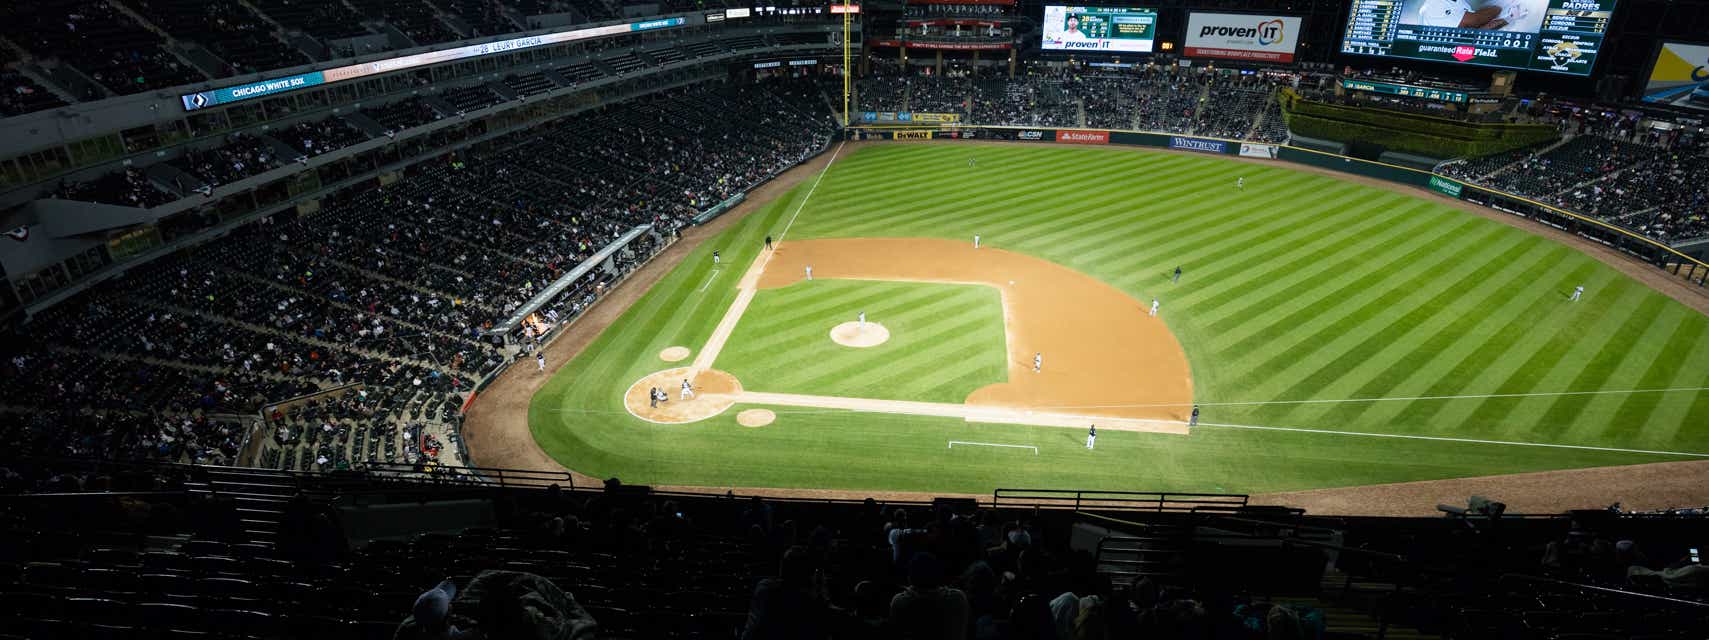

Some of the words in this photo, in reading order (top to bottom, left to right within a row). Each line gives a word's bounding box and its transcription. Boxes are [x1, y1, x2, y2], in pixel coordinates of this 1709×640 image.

[1562, 2, 1600, 11] PADRES
[1200, 25, 1257, 38] proven
[1263, 26, 1278, 39] IT
[492, 41, 514, 52] LEURY
[516, 37, 542, 48] GARCIA
[1065, 40, 1098, 49] proven
[1418, 45, 1456, 54] guaranteed
[1456, 46, 1473, 55] Rate
[232, 85, 266, 97] CHICAGO
[266, 81, 290, 90] WHITE
[290, 77, 305, 87] SOX
[1174, 137, 1222, 150] WINTRUST
